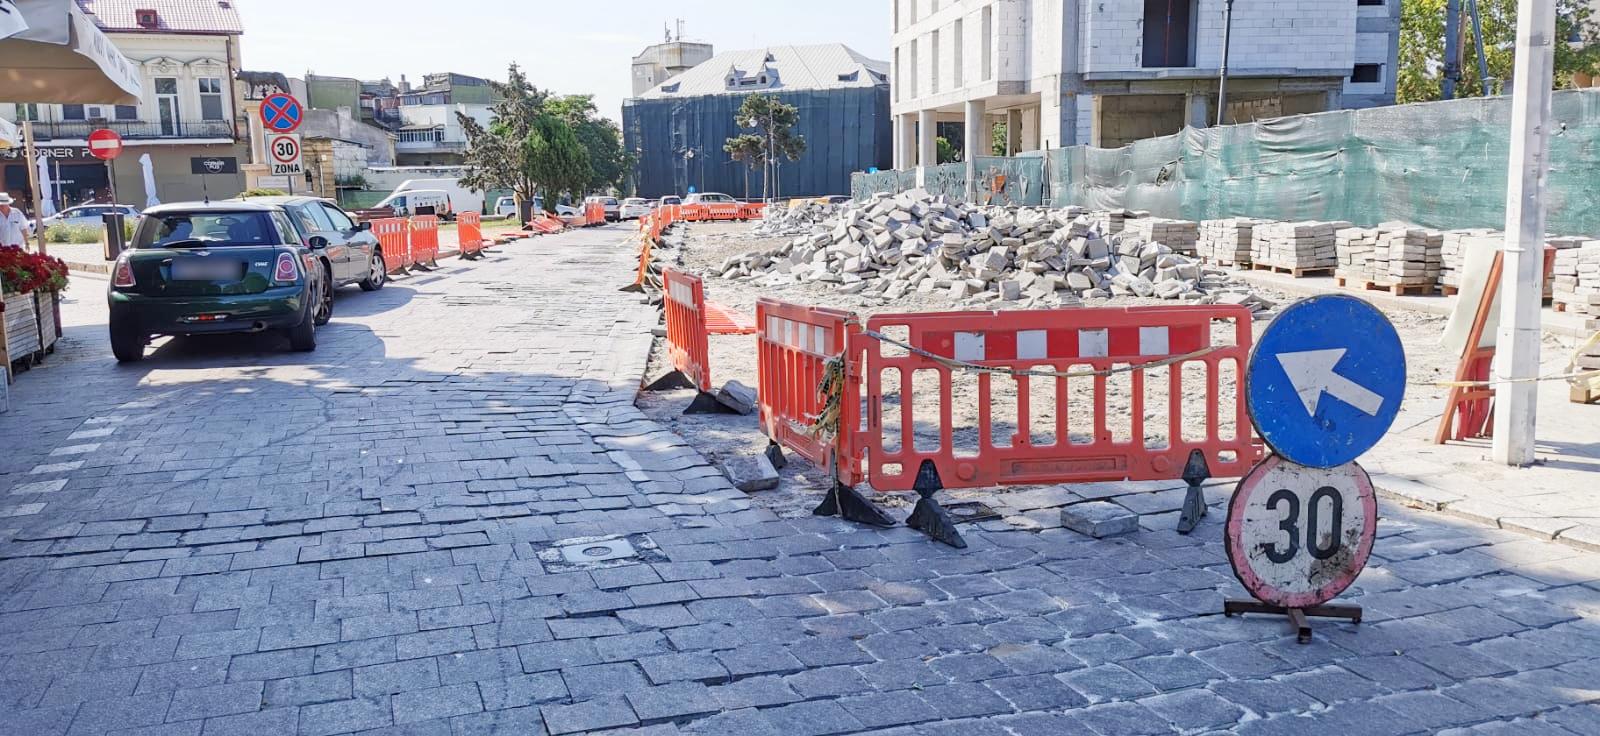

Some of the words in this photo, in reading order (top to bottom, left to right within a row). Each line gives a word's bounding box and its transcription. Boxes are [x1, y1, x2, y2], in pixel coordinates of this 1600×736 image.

[277, 143, 294, 156] 30
[275, 164, 301, 174] ZONA
[1265, 486, 1343, 564] 30
